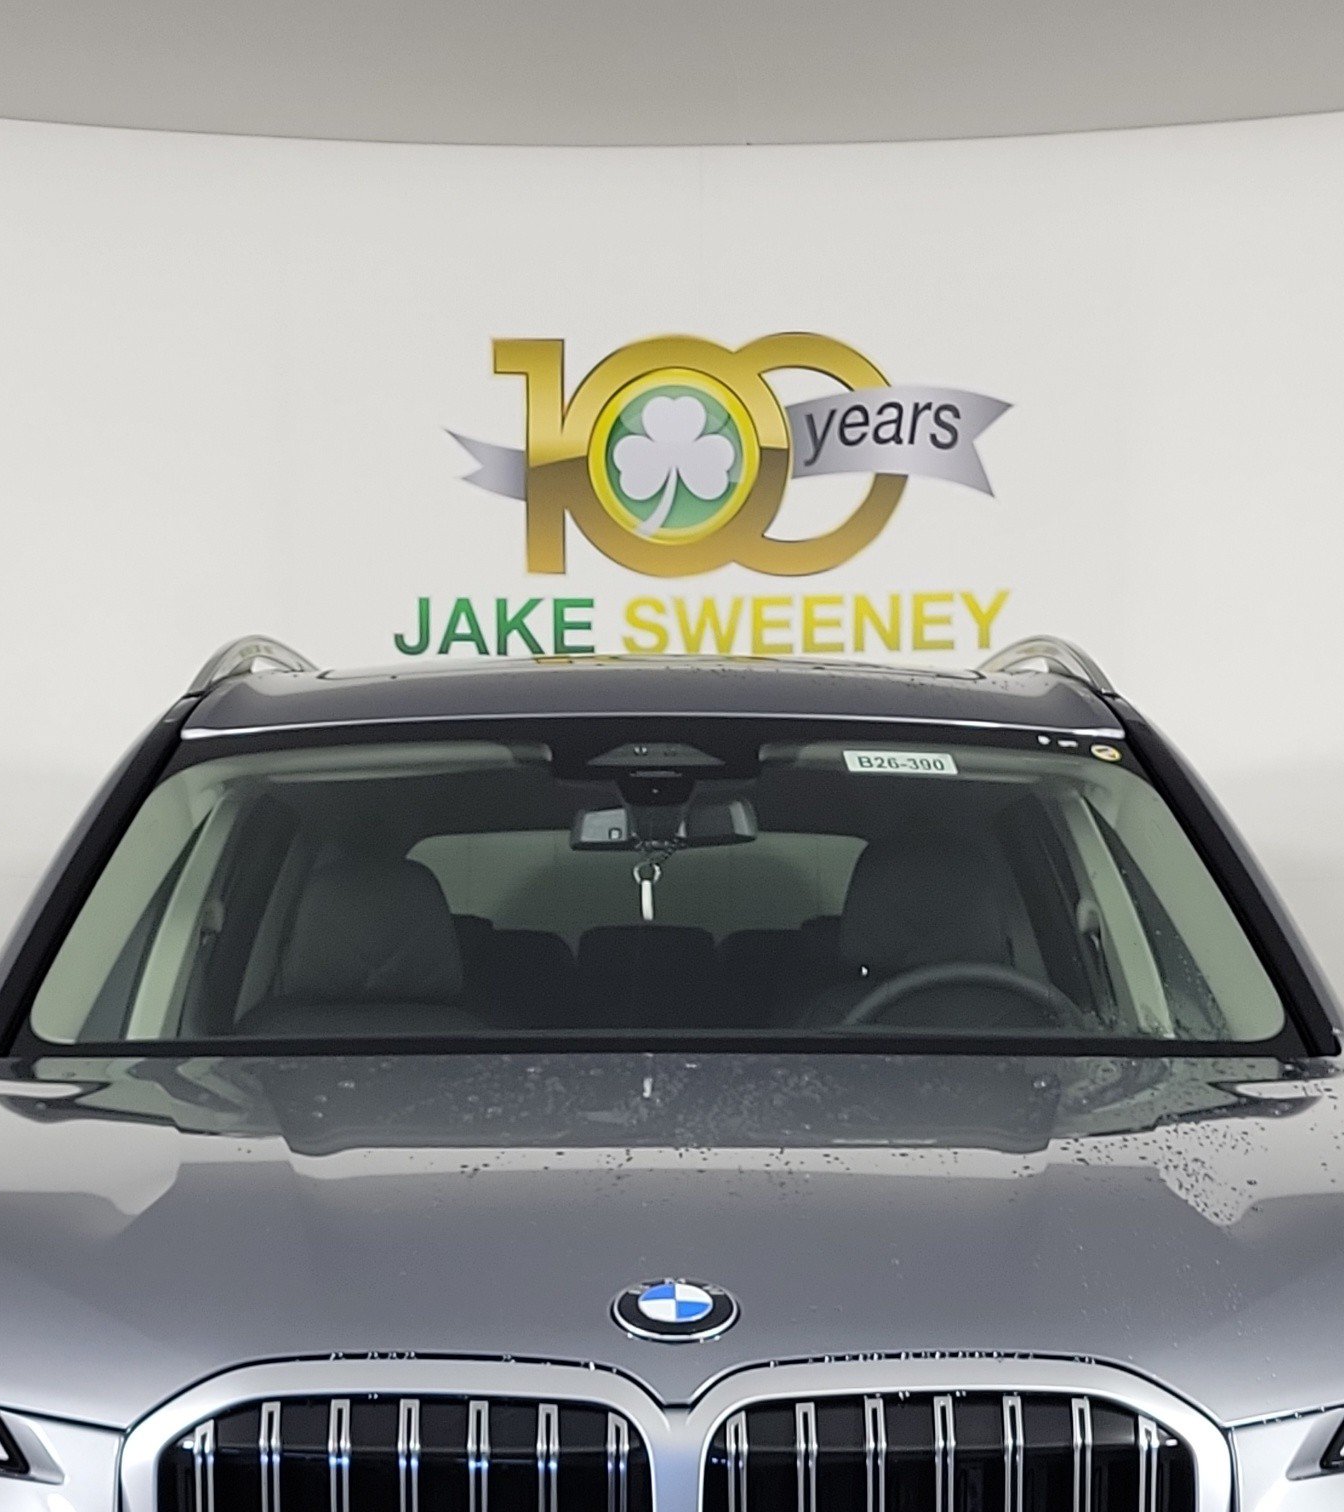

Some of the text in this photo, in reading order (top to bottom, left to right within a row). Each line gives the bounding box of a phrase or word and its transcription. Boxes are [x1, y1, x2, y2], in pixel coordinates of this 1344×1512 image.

[492, 332, 962, 578] 100 years
[393, 590, 1010, 656] JAKE SWEENEY
